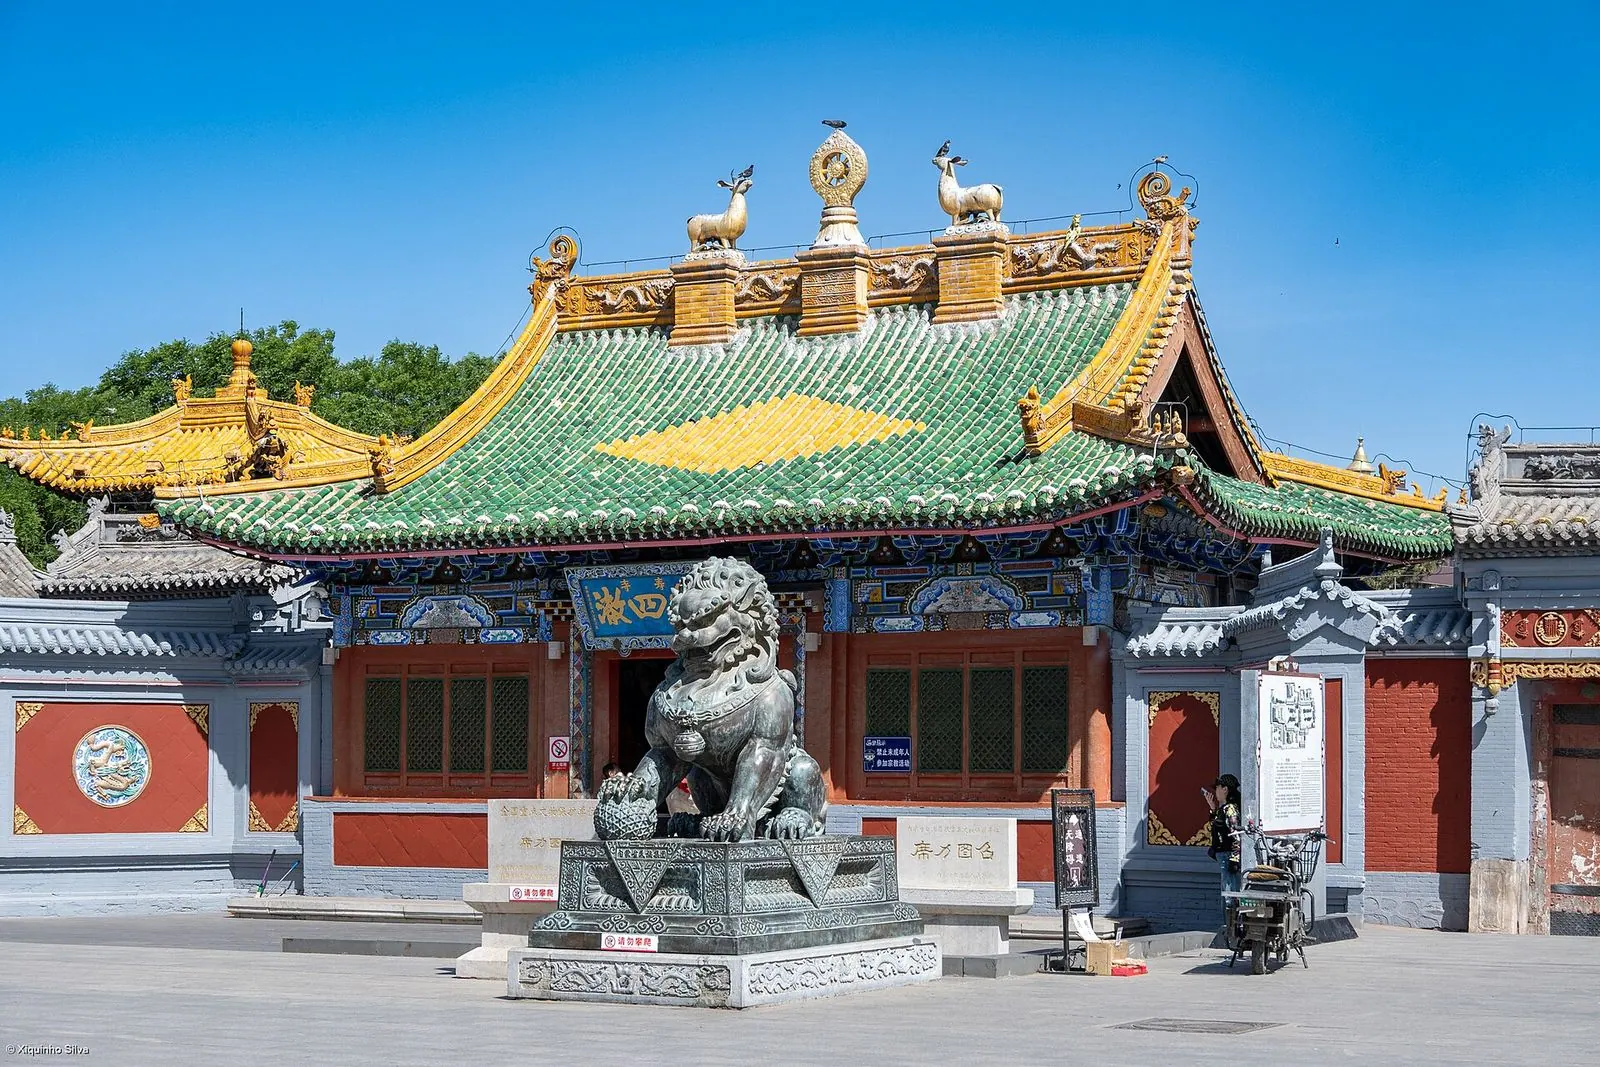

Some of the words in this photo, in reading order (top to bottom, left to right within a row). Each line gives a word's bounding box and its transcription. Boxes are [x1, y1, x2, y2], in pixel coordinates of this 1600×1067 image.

[877, 748, 910, 756] 禁止未成年人
[877, 759, 910, 767] 参加宗教活动
[524, 888, 554, 898] 请勿攀爬
[617, 936, 652, 947] 请勿攀爬
